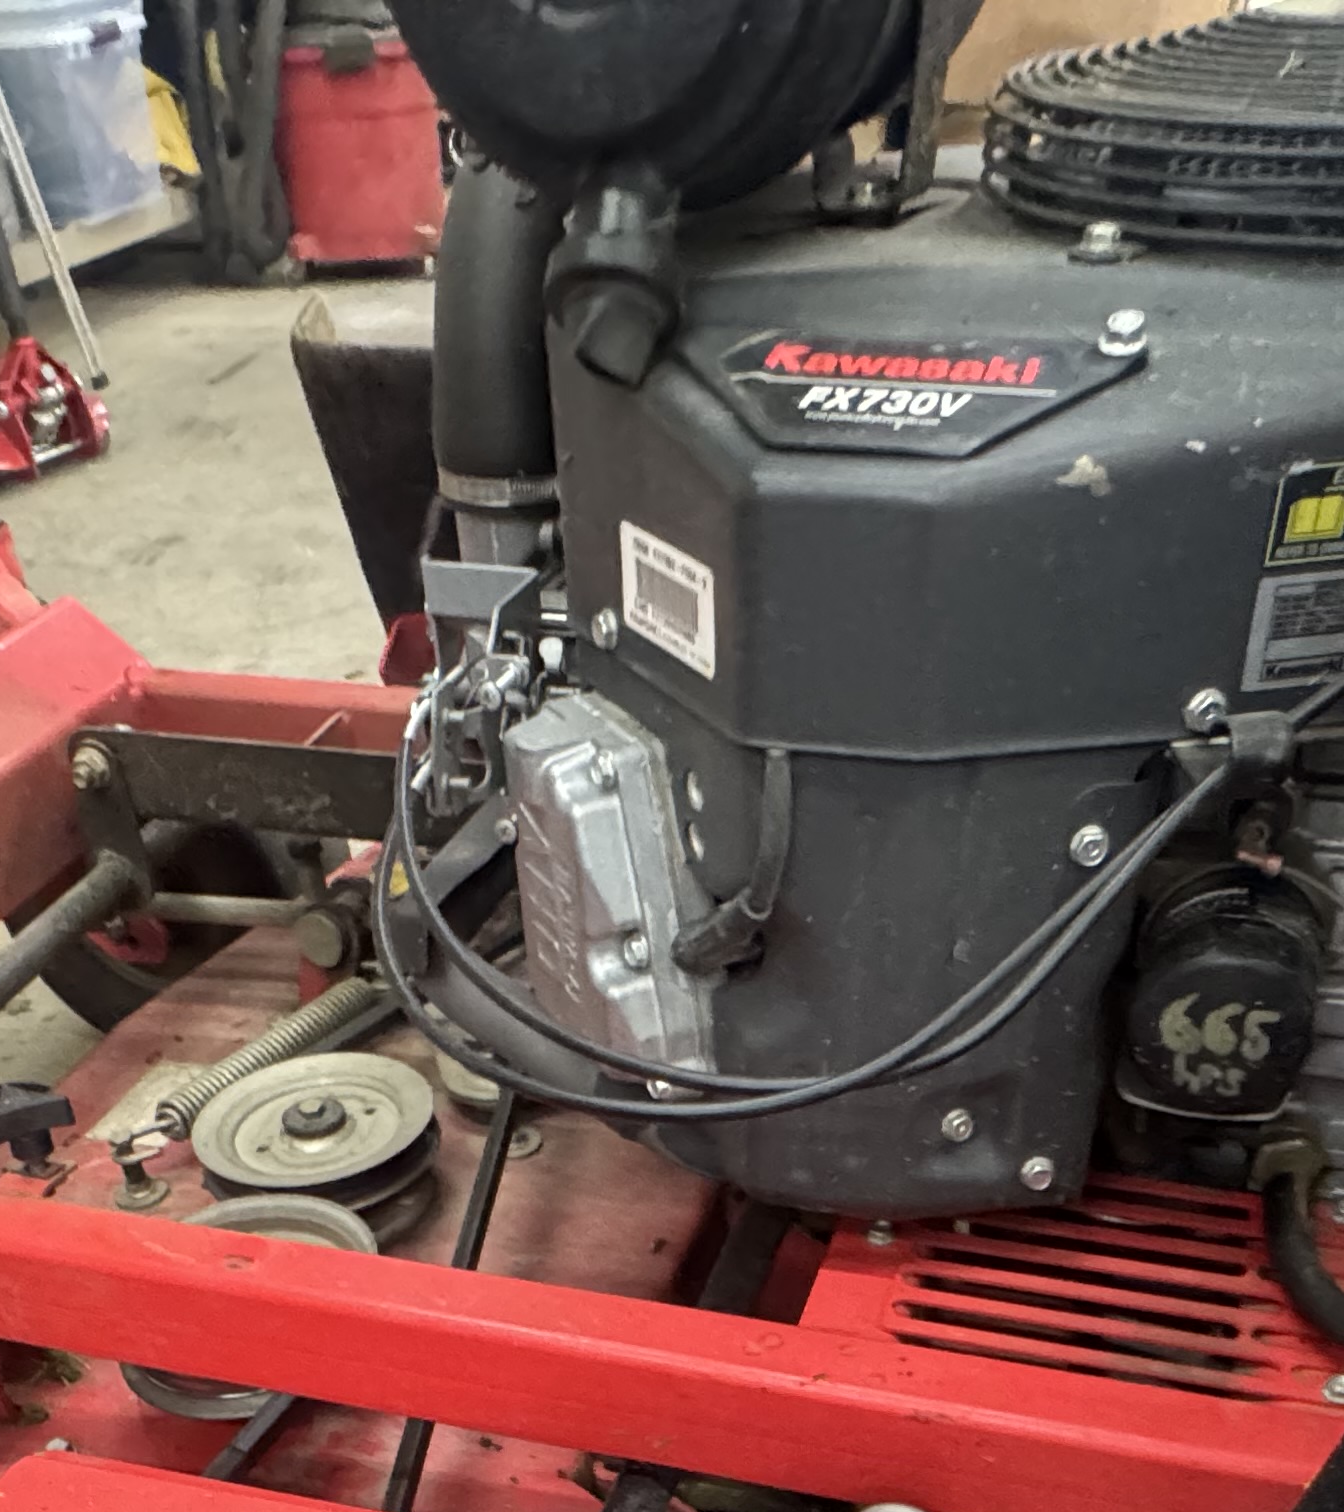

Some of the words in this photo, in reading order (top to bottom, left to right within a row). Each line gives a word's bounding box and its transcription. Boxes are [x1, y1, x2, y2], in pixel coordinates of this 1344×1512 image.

[764, 342, 1042, 384] Kawasaki
[798, 386, 974, 418] FX730V
[1158, 991, 1283, 1062] 665
